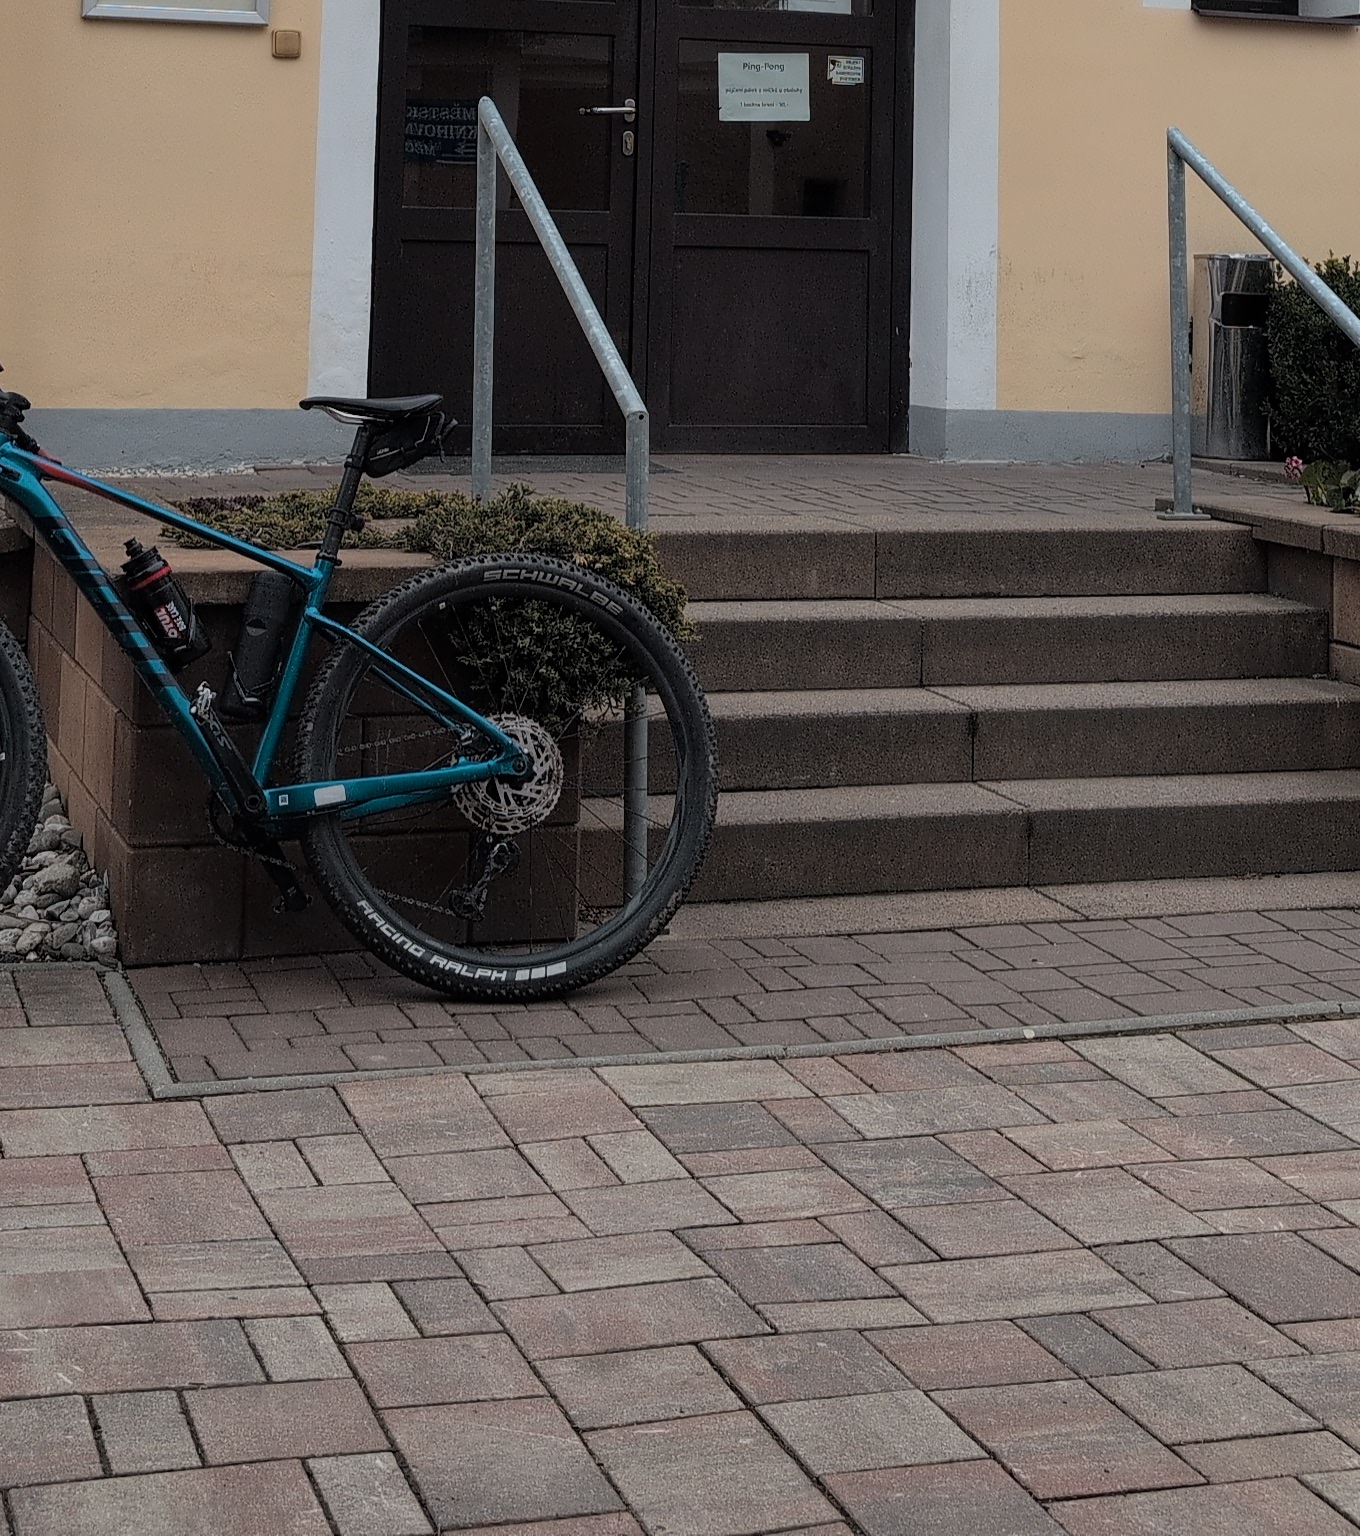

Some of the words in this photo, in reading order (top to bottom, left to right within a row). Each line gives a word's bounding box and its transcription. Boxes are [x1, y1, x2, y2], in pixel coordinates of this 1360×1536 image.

[743, 62, 785, 72] Ping-Pong
[483, 569, 623, 615] SCHWALBE
[153, 606, 182, 639] OTUL
[357, 899, 426, 958] RACING
[429, 954, 507, 981] RALPH
